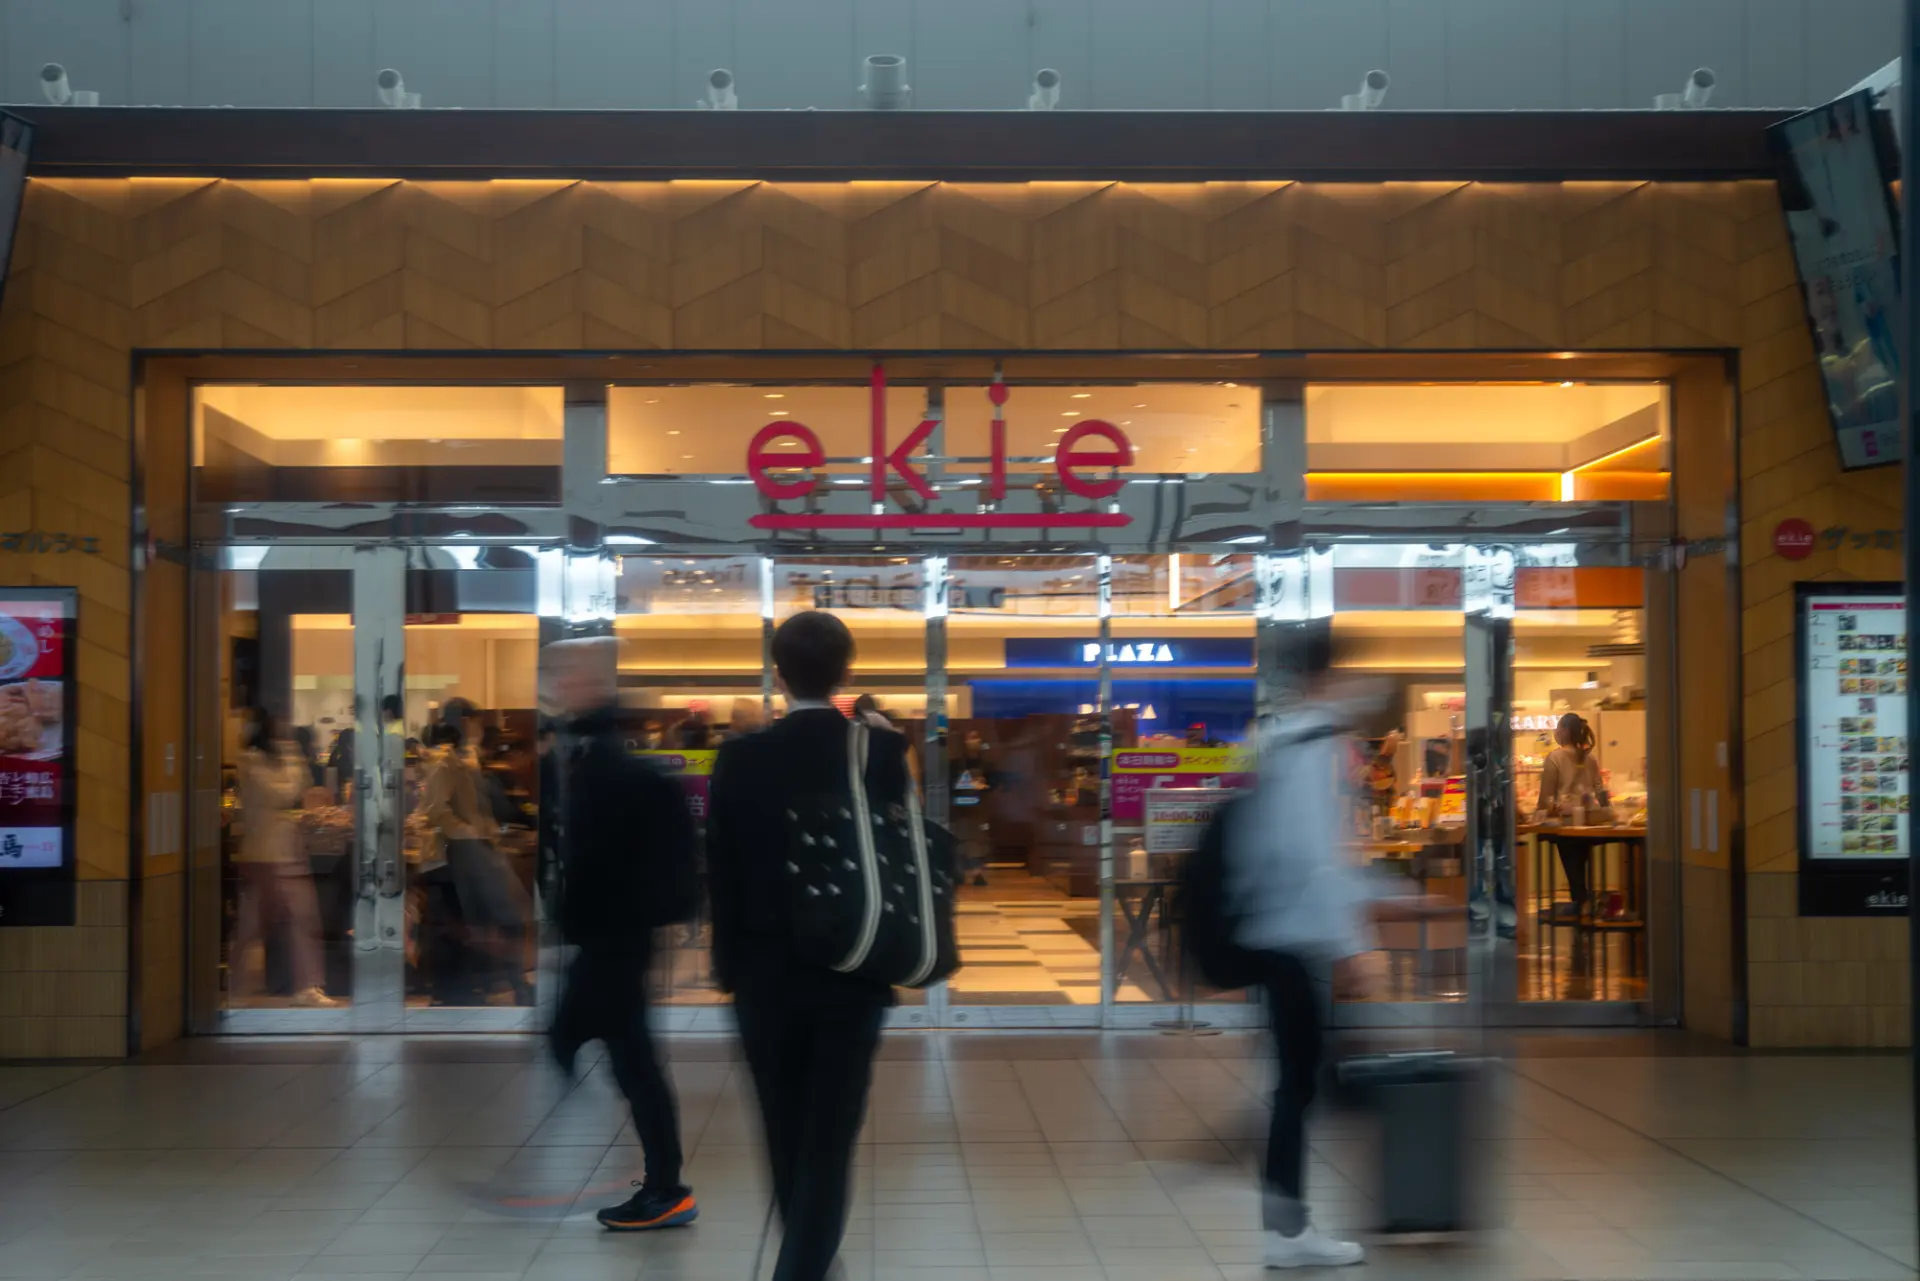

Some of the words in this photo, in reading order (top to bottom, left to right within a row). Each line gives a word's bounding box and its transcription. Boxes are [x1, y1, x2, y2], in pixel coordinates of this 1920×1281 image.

[747, 364, 1135, 500] ekie
[1822, 525, 1905, 551] ザッカ
[1083, 643, 1174, 662] PLAZA
